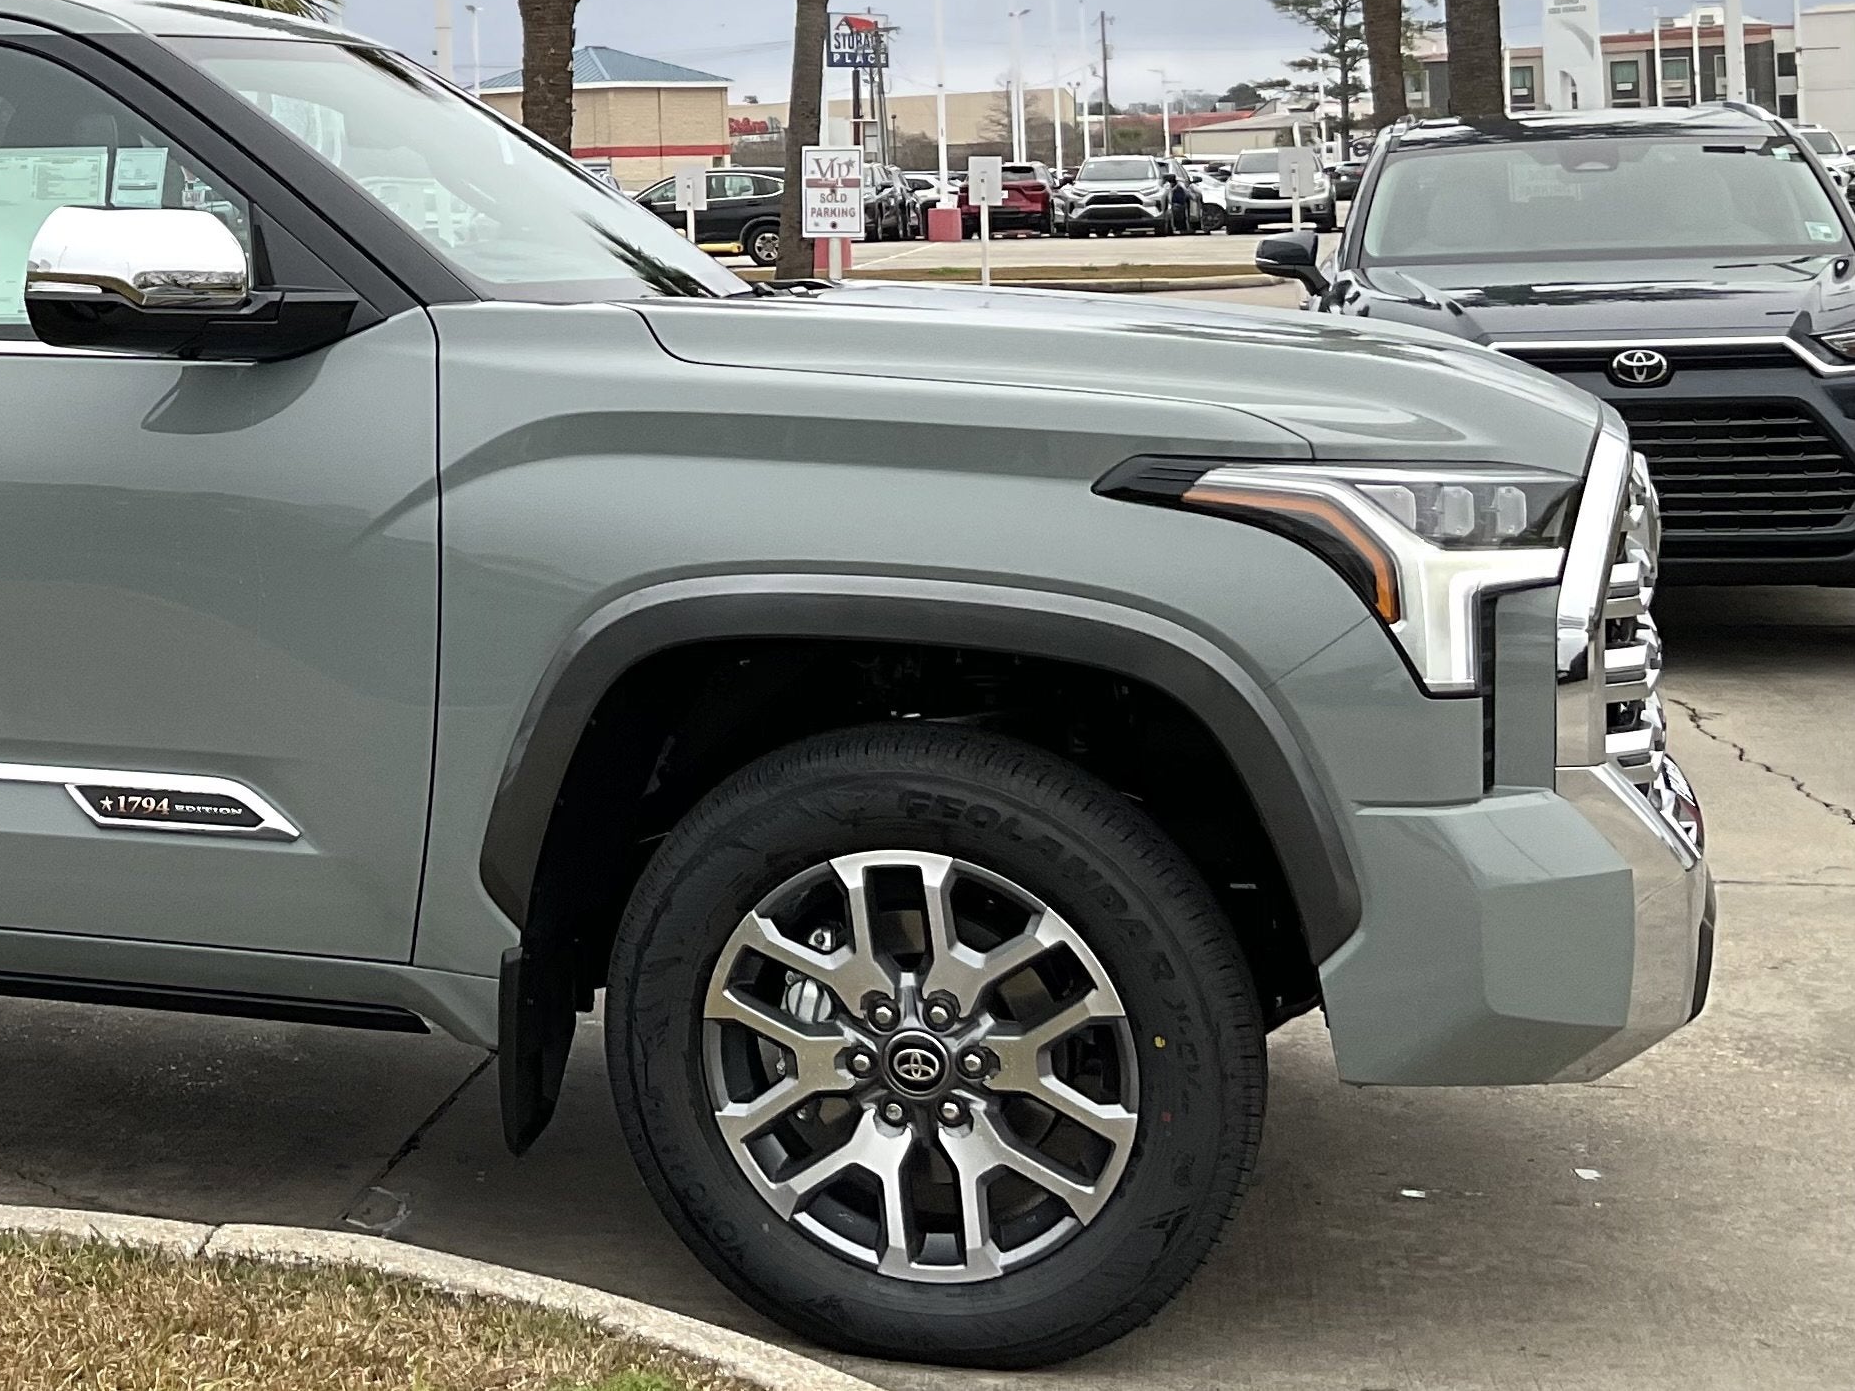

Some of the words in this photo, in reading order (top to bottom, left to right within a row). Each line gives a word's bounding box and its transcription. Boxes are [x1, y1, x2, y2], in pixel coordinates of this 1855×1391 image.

[832, 53, 887, 64] PLACE
[819, 192, 848, 204] SOLD
[810, 207, 856, 218] PARKING
[117, 795, 170, 815] 1794
[174, 804, 243, 815] EDITION
